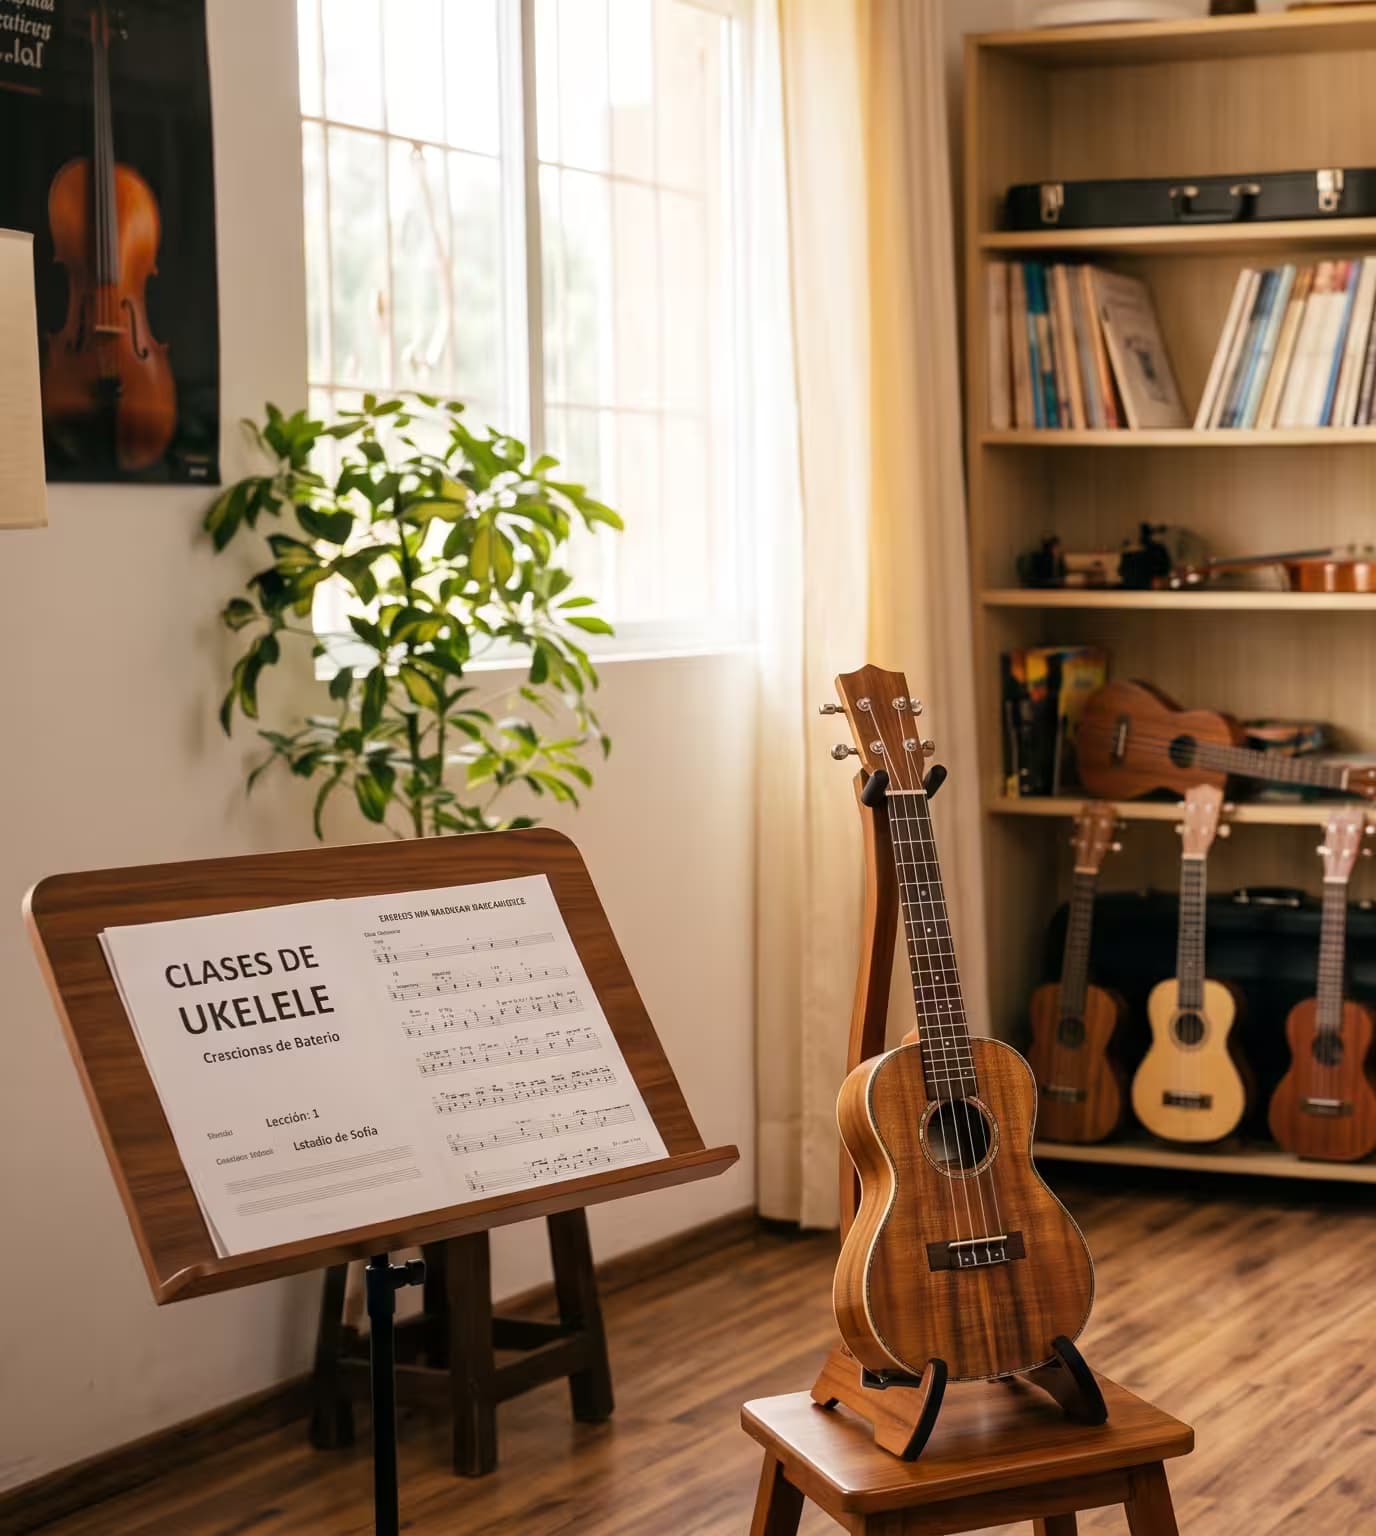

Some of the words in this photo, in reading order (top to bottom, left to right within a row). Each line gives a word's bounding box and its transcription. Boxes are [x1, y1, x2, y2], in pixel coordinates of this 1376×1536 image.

[165, 952, 273, 989] CLASES
[277, 945, 320, 972] DE
[178, 985, 335, 1035] UKELELE
[275, 1039, 293, 1052] de
[294, 1031, 340, 1049] Baterio
[265, 1111, 311, 1128] Lección:
[313, 1108, 320, 1119] 1
[334, 1132, 349, 1143] de
